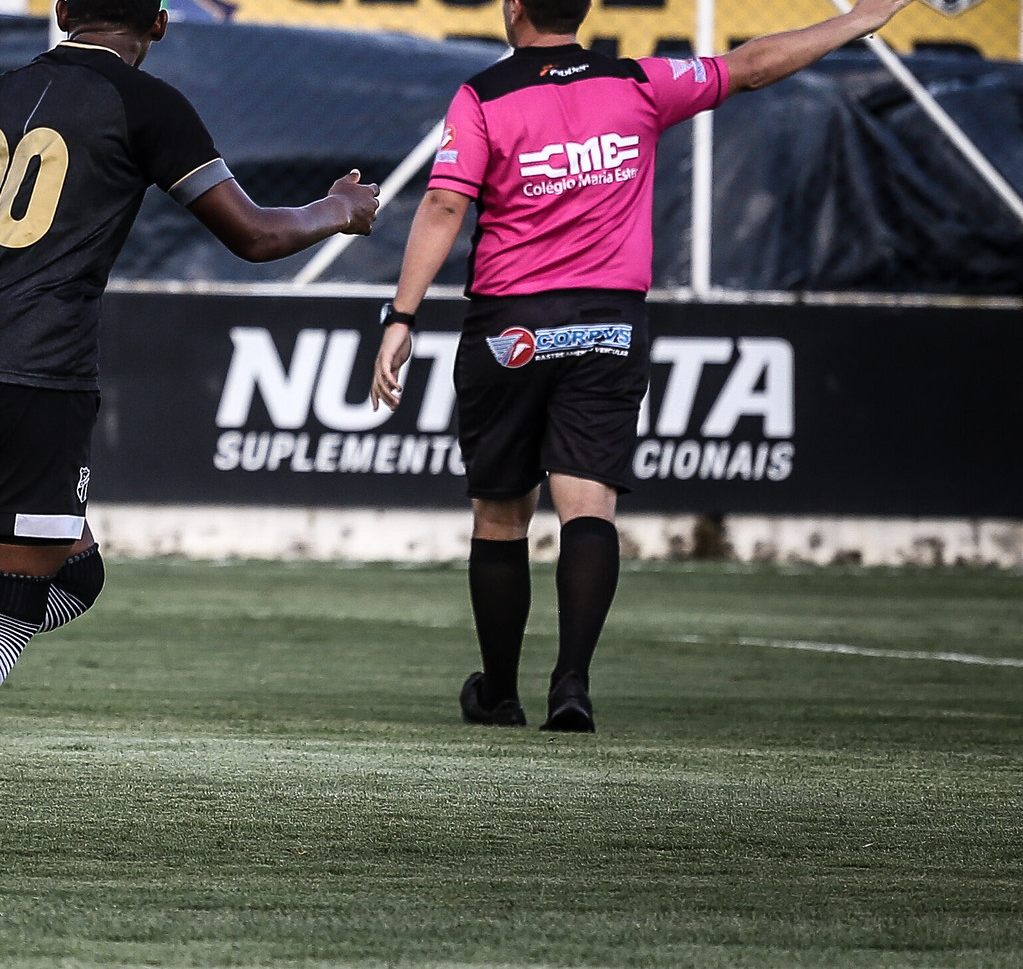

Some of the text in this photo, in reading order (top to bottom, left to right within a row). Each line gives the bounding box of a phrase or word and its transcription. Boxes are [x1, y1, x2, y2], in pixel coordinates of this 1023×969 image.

[523, 178, 576, 197] Colégio
[578, 171, 613, 188] Maria
[215, 327, 795, 439] NUTTA
[213, 430, 796, 482] SUPLEMENTO CIONAIS
